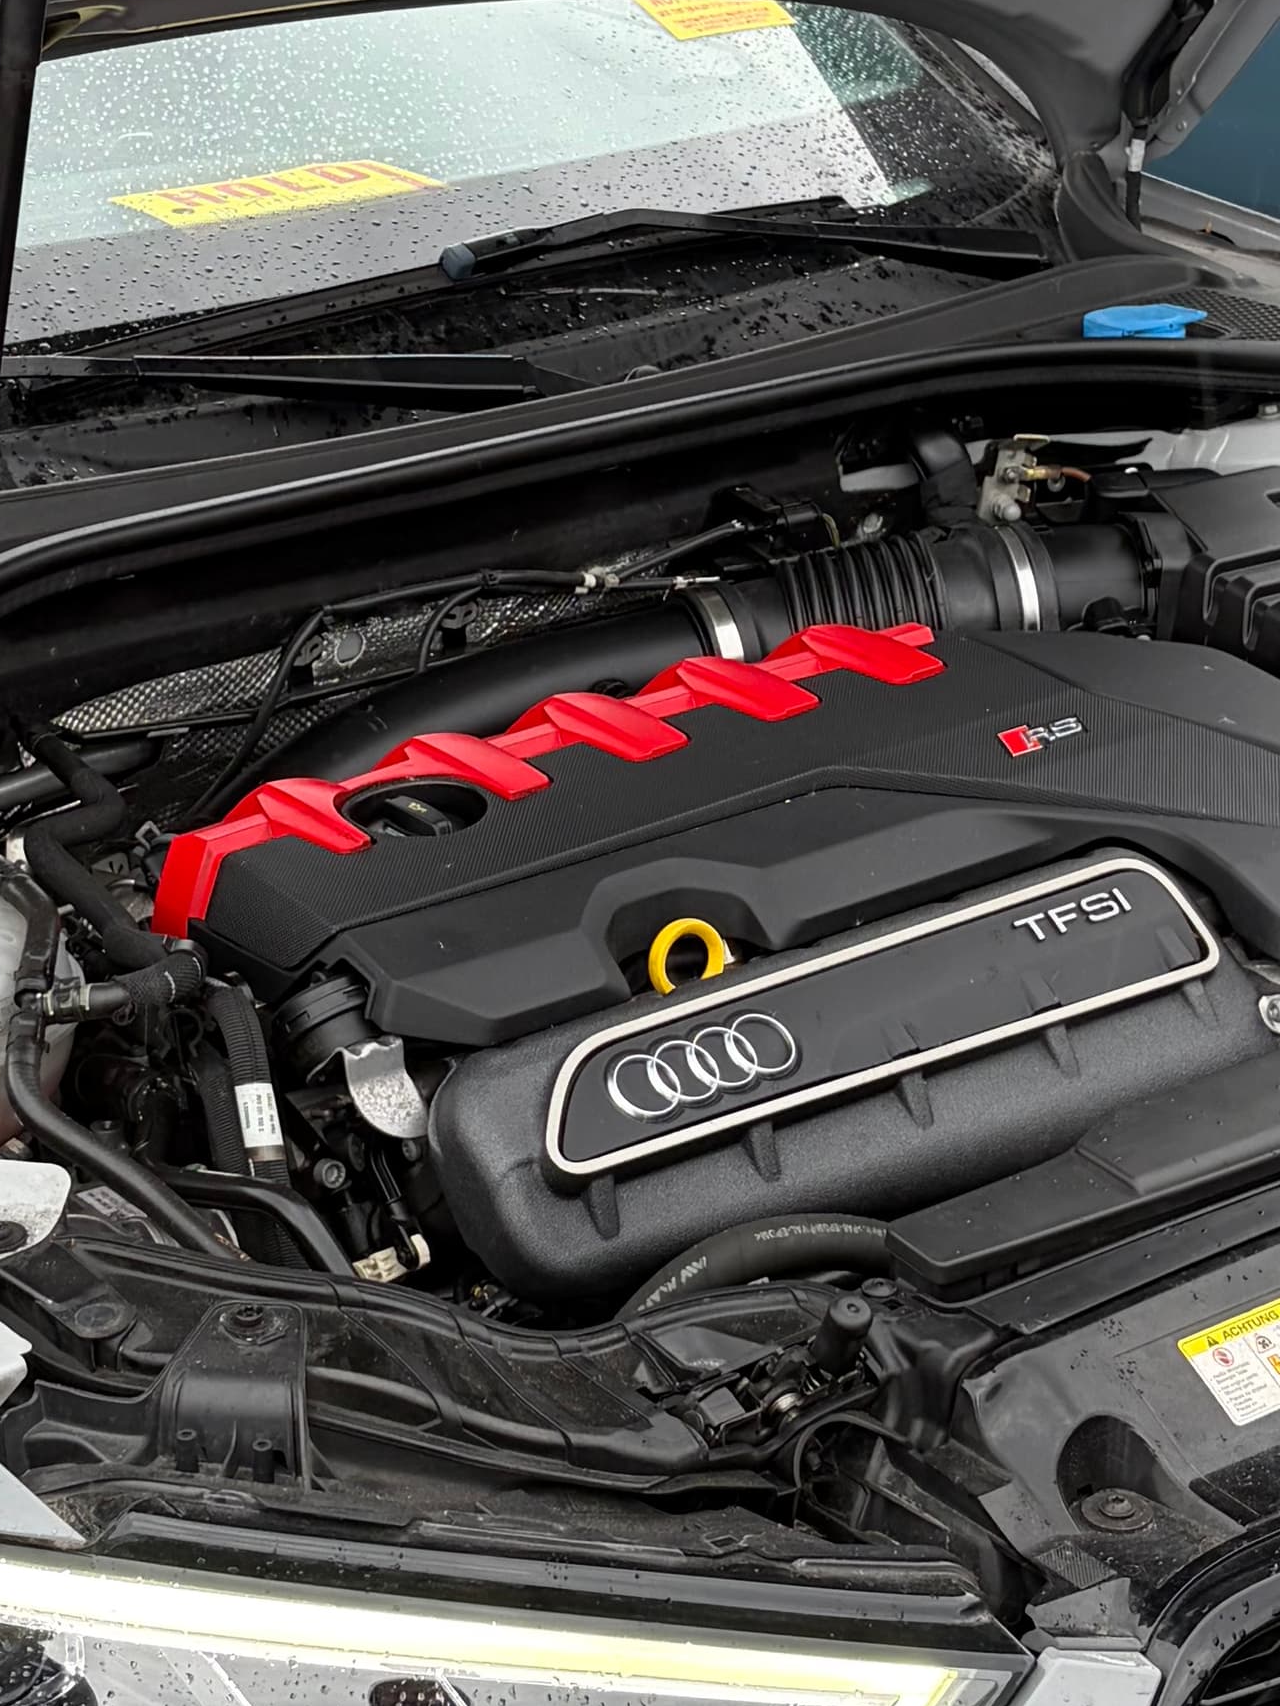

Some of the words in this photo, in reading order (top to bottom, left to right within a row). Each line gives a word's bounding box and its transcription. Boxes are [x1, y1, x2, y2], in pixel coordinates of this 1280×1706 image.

[1012, 717, 1082, 751] RS
[1013, 887, 1132, 941] TFSI
[1223, 1309, 1280, 1342] ACHTUNG
